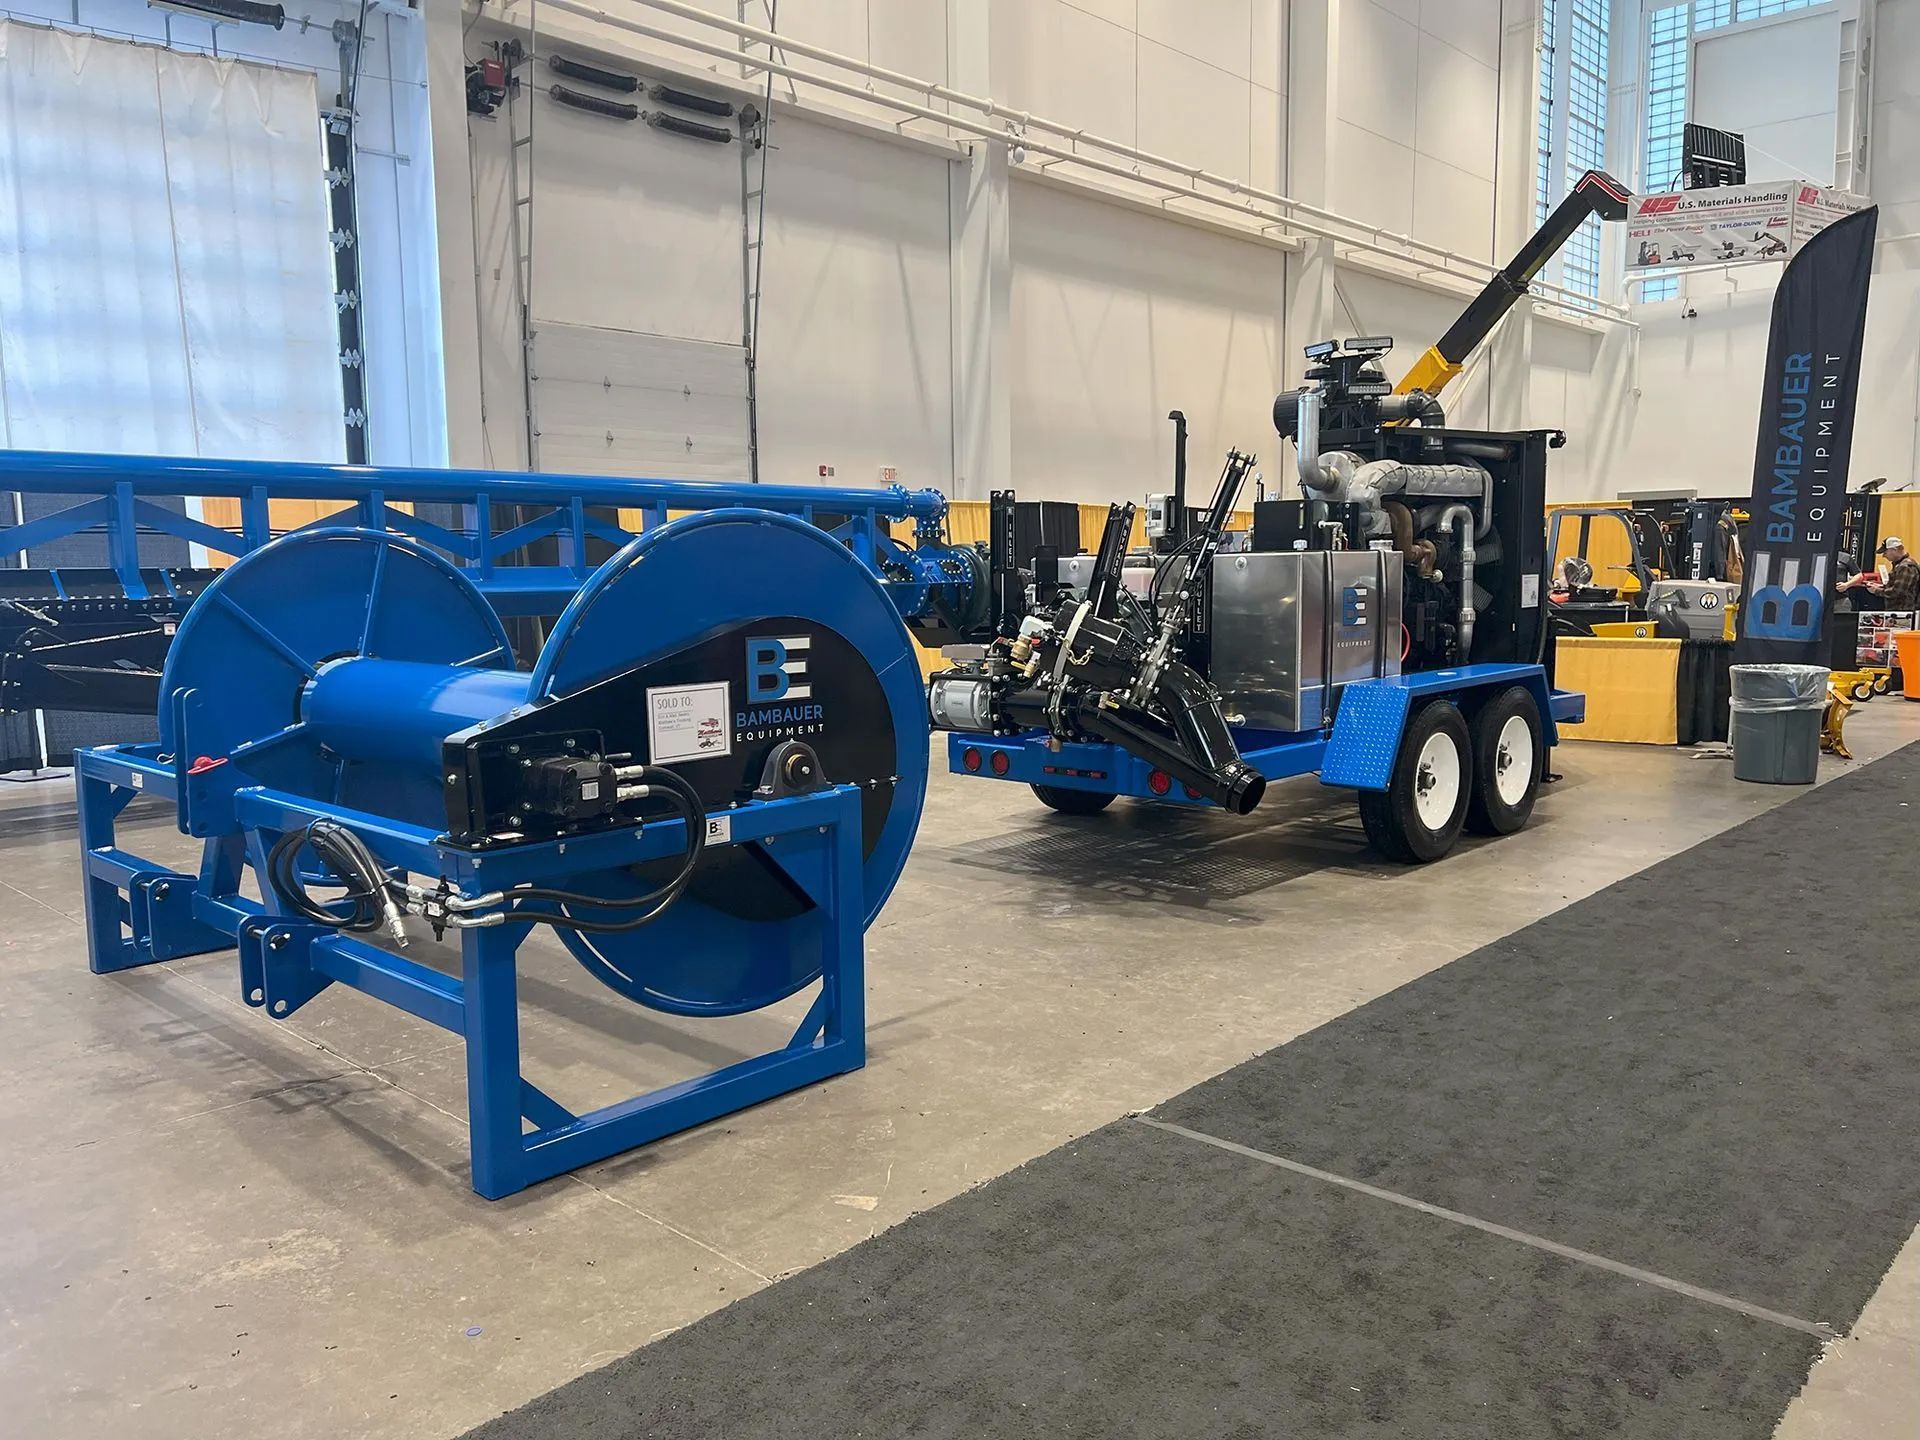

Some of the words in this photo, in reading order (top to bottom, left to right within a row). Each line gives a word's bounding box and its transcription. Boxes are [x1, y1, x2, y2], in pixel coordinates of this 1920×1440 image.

[1678, 200, 1696, 210] U.S.
[1698, 196, 1741, 208] Materials
[1743, 192, 1788, 204] Handling
[1629, 229, 1651, 238] HELI
[1719, 220, 1762, 229] TAYLOR-DUNN
[1766, 351, 1812, 543] BAMBAUER
[1807, 353, 1841, 542] EQUIPMENT
[1853, 510, 1863, 518] 15
[746, 634, 812, 704] BE
[657, 697, 678, 709] SOLD
[681, 696, 693, 707] TO:
[736, 704, 824, 728] BAMBAUER
[736, 723, 824, 742] EQUIPMENT
